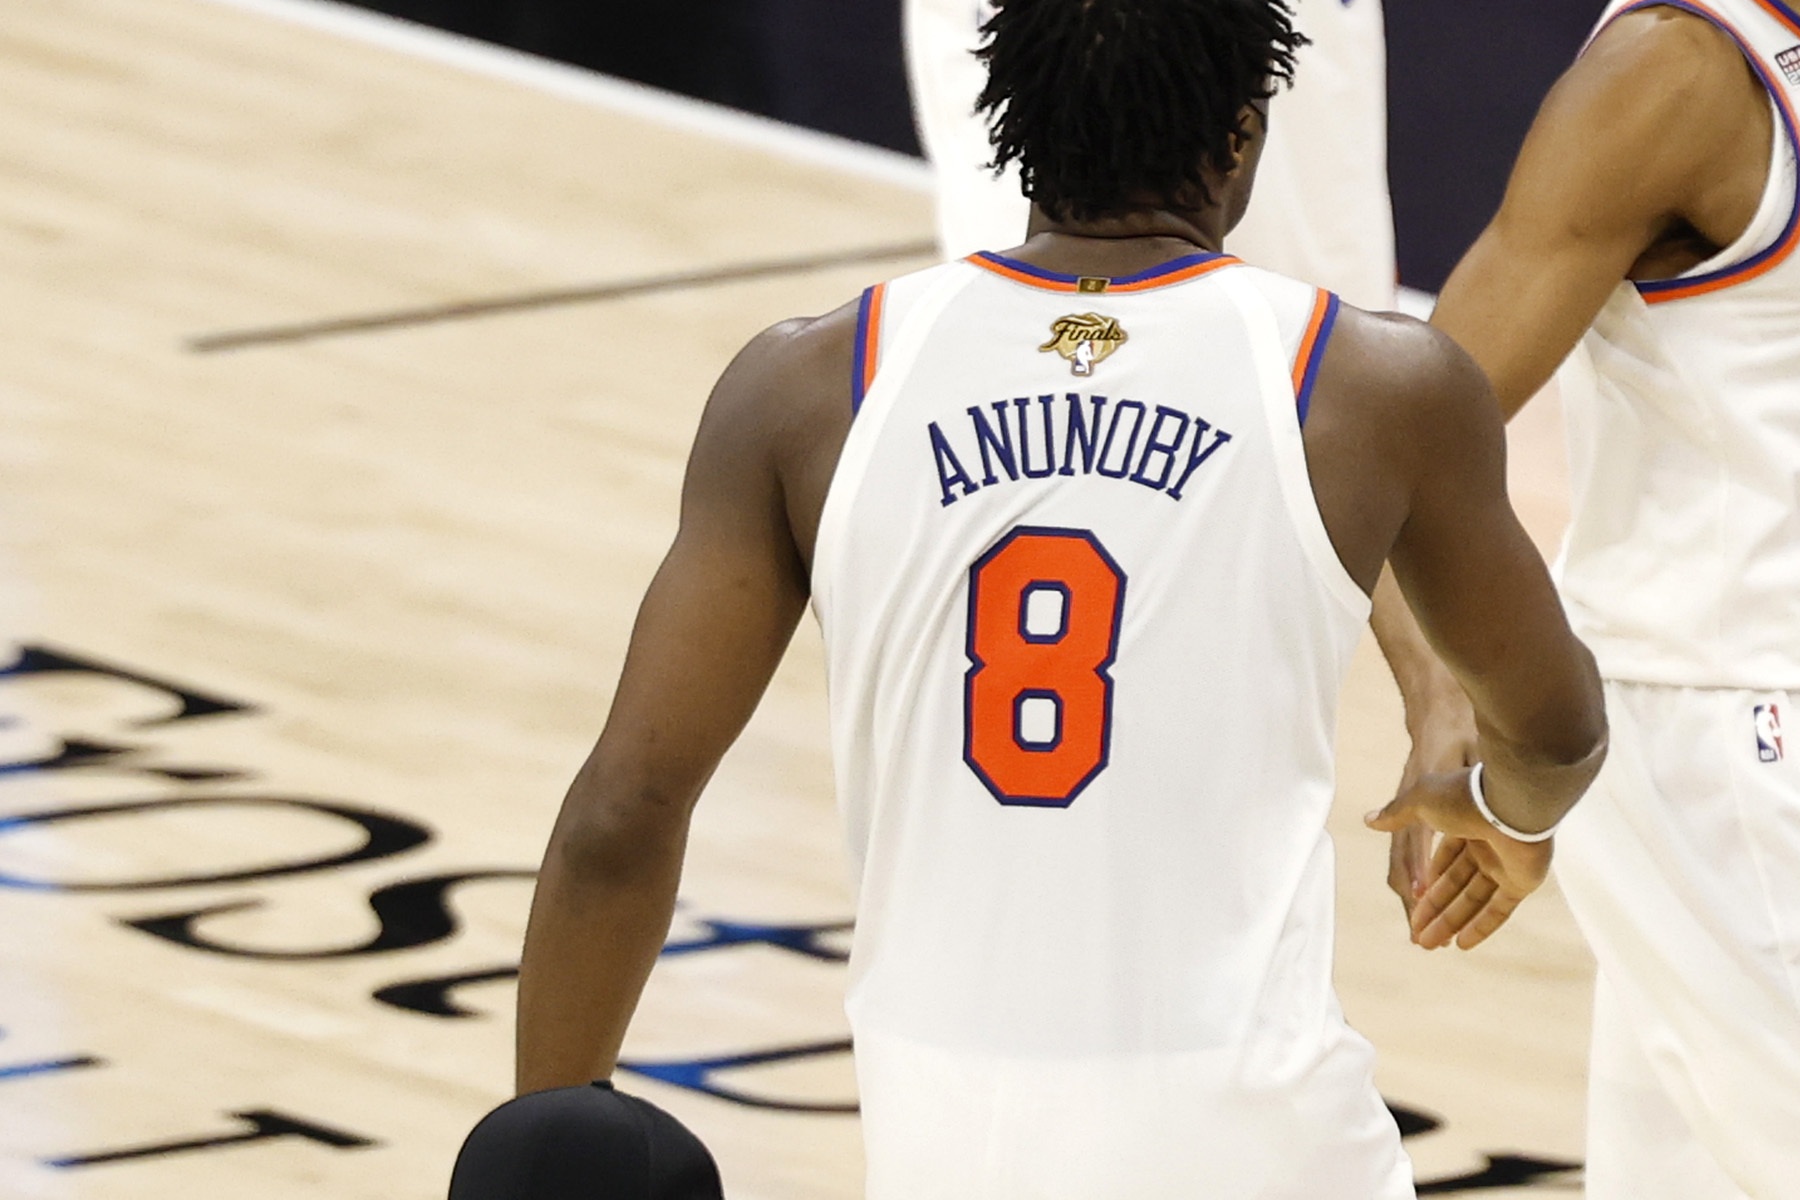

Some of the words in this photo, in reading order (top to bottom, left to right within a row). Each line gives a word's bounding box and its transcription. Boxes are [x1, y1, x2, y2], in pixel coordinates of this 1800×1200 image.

[1039, 318, 1123, 352] Finals
[927, 392, 1232, 507] ANUNOBY
[963, 525, 1128, 809] 8
